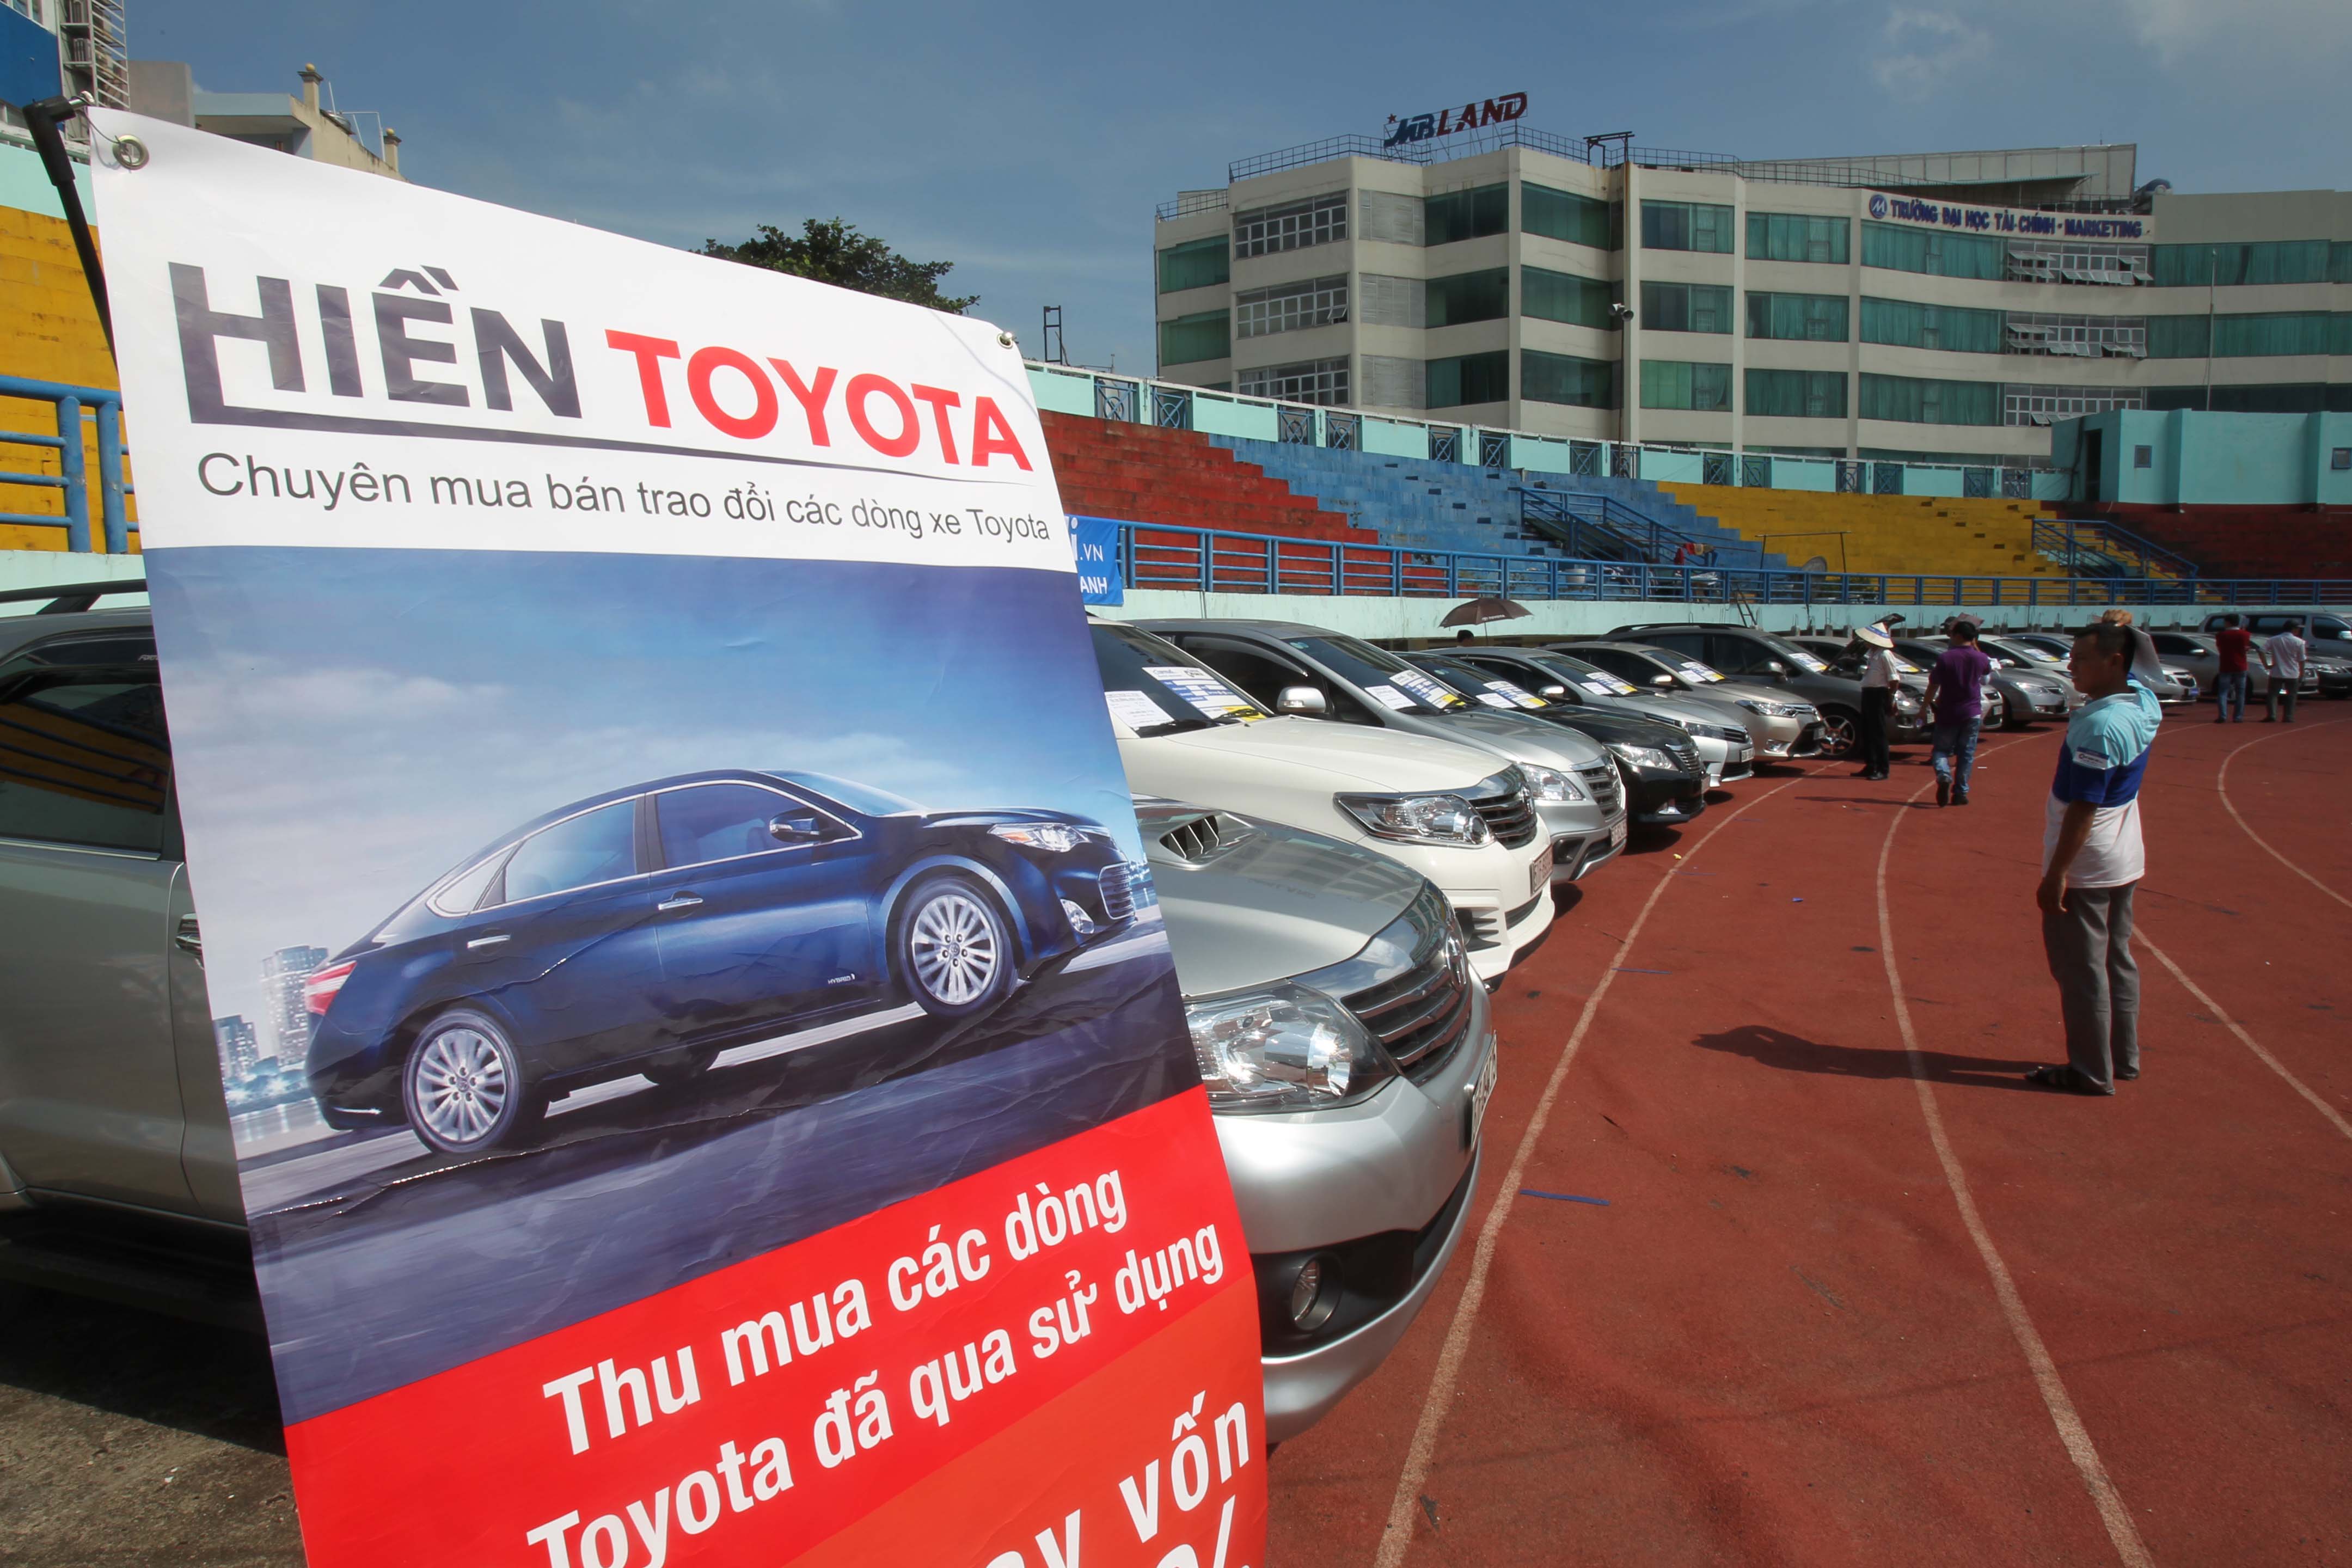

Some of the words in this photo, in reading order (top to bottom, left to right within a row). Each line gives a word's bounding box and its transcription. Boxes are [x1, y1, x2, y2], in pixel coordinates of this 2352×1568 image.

[1891, 199, 1939, 224] TRƯỜNG
[1942, 206, 1962, 228] ĐẠI
[1965, 210, 1990, 232] HỌC
[2064, 219, 2142, 238] MARKETING
[168, 261, 583, 423] HIỀN
[605, 329, 1033, 471] TOYOTA
[198, 452, 412, 511] Chuyên
[430, 475, 532, 507] mua
[546, 473, 625, 512] bán
[636, 482, 711, 518] trao
[723, 481, 775, 521] đổi
[786, 493, 843, 525] các
[852, 498, 923, 539] dòng
[928, 512, 961, 535] xe
[965, 508, 1050, 543] Toyota
[526, 1437, 795, 1568] Toyota
[813, 1369, 893, 1468] đã
[909, 1328, 1017, 1427] qua
[1028, 1270, 1098, 1358] sử
[1114, 1223, 1223, 1311] dụng
[542, 1345, 701, 1455] Thu
[721, 1278, 872, 1387] mua
[887, 1224, 991, 1312] các
[1004, 1169, 1127, 1261] dòng
[1118, 1390, 1250, 1543] vốn
